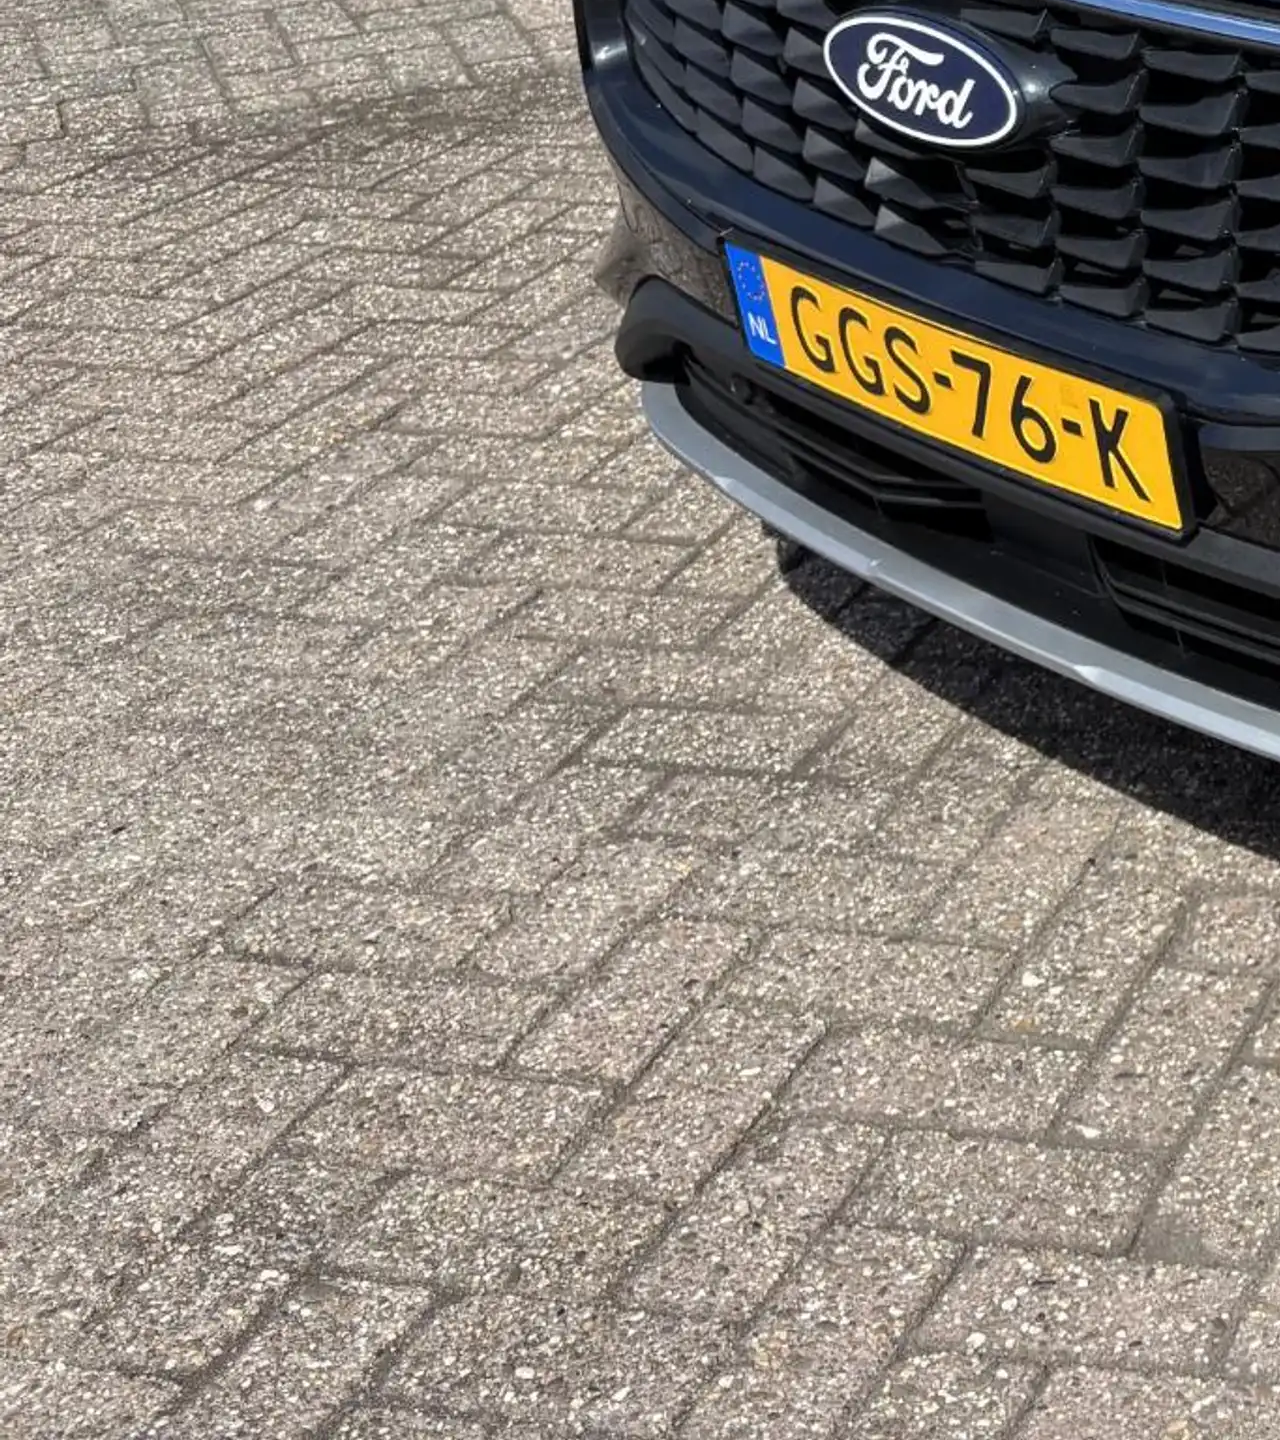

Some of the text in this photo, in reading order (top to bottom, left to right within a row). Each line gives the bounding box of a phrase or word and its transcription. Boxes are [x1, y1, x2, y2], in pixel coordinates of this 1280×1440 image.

[857, 32, 976, 129] Ford
[747, 311, 777, 345] NL
[790, 285, 1153, 503] GGS-76-K
